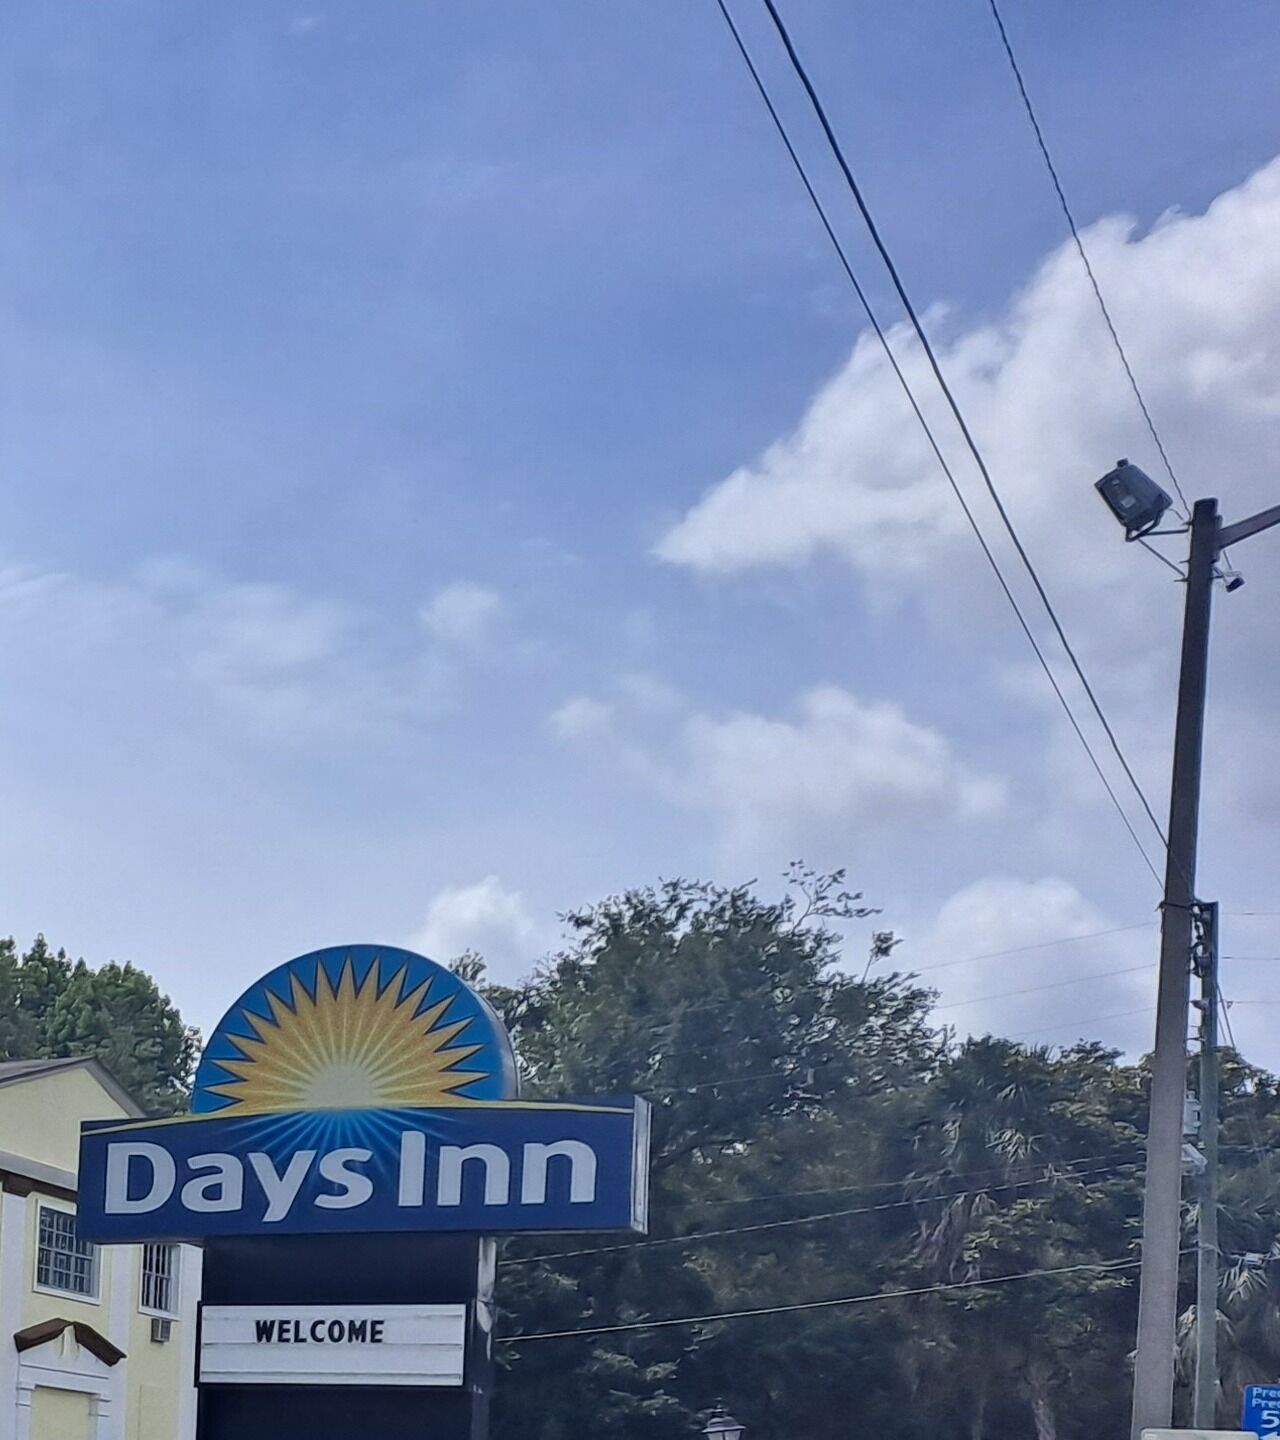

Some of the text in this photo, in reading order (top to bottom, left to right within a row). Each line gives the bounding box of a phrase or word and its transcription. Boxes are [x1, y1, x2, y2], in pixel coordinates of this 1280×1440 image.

[104, 1130, 598, 1223] Days Inn
[255, 1319, 385, 1343] WELCOME
